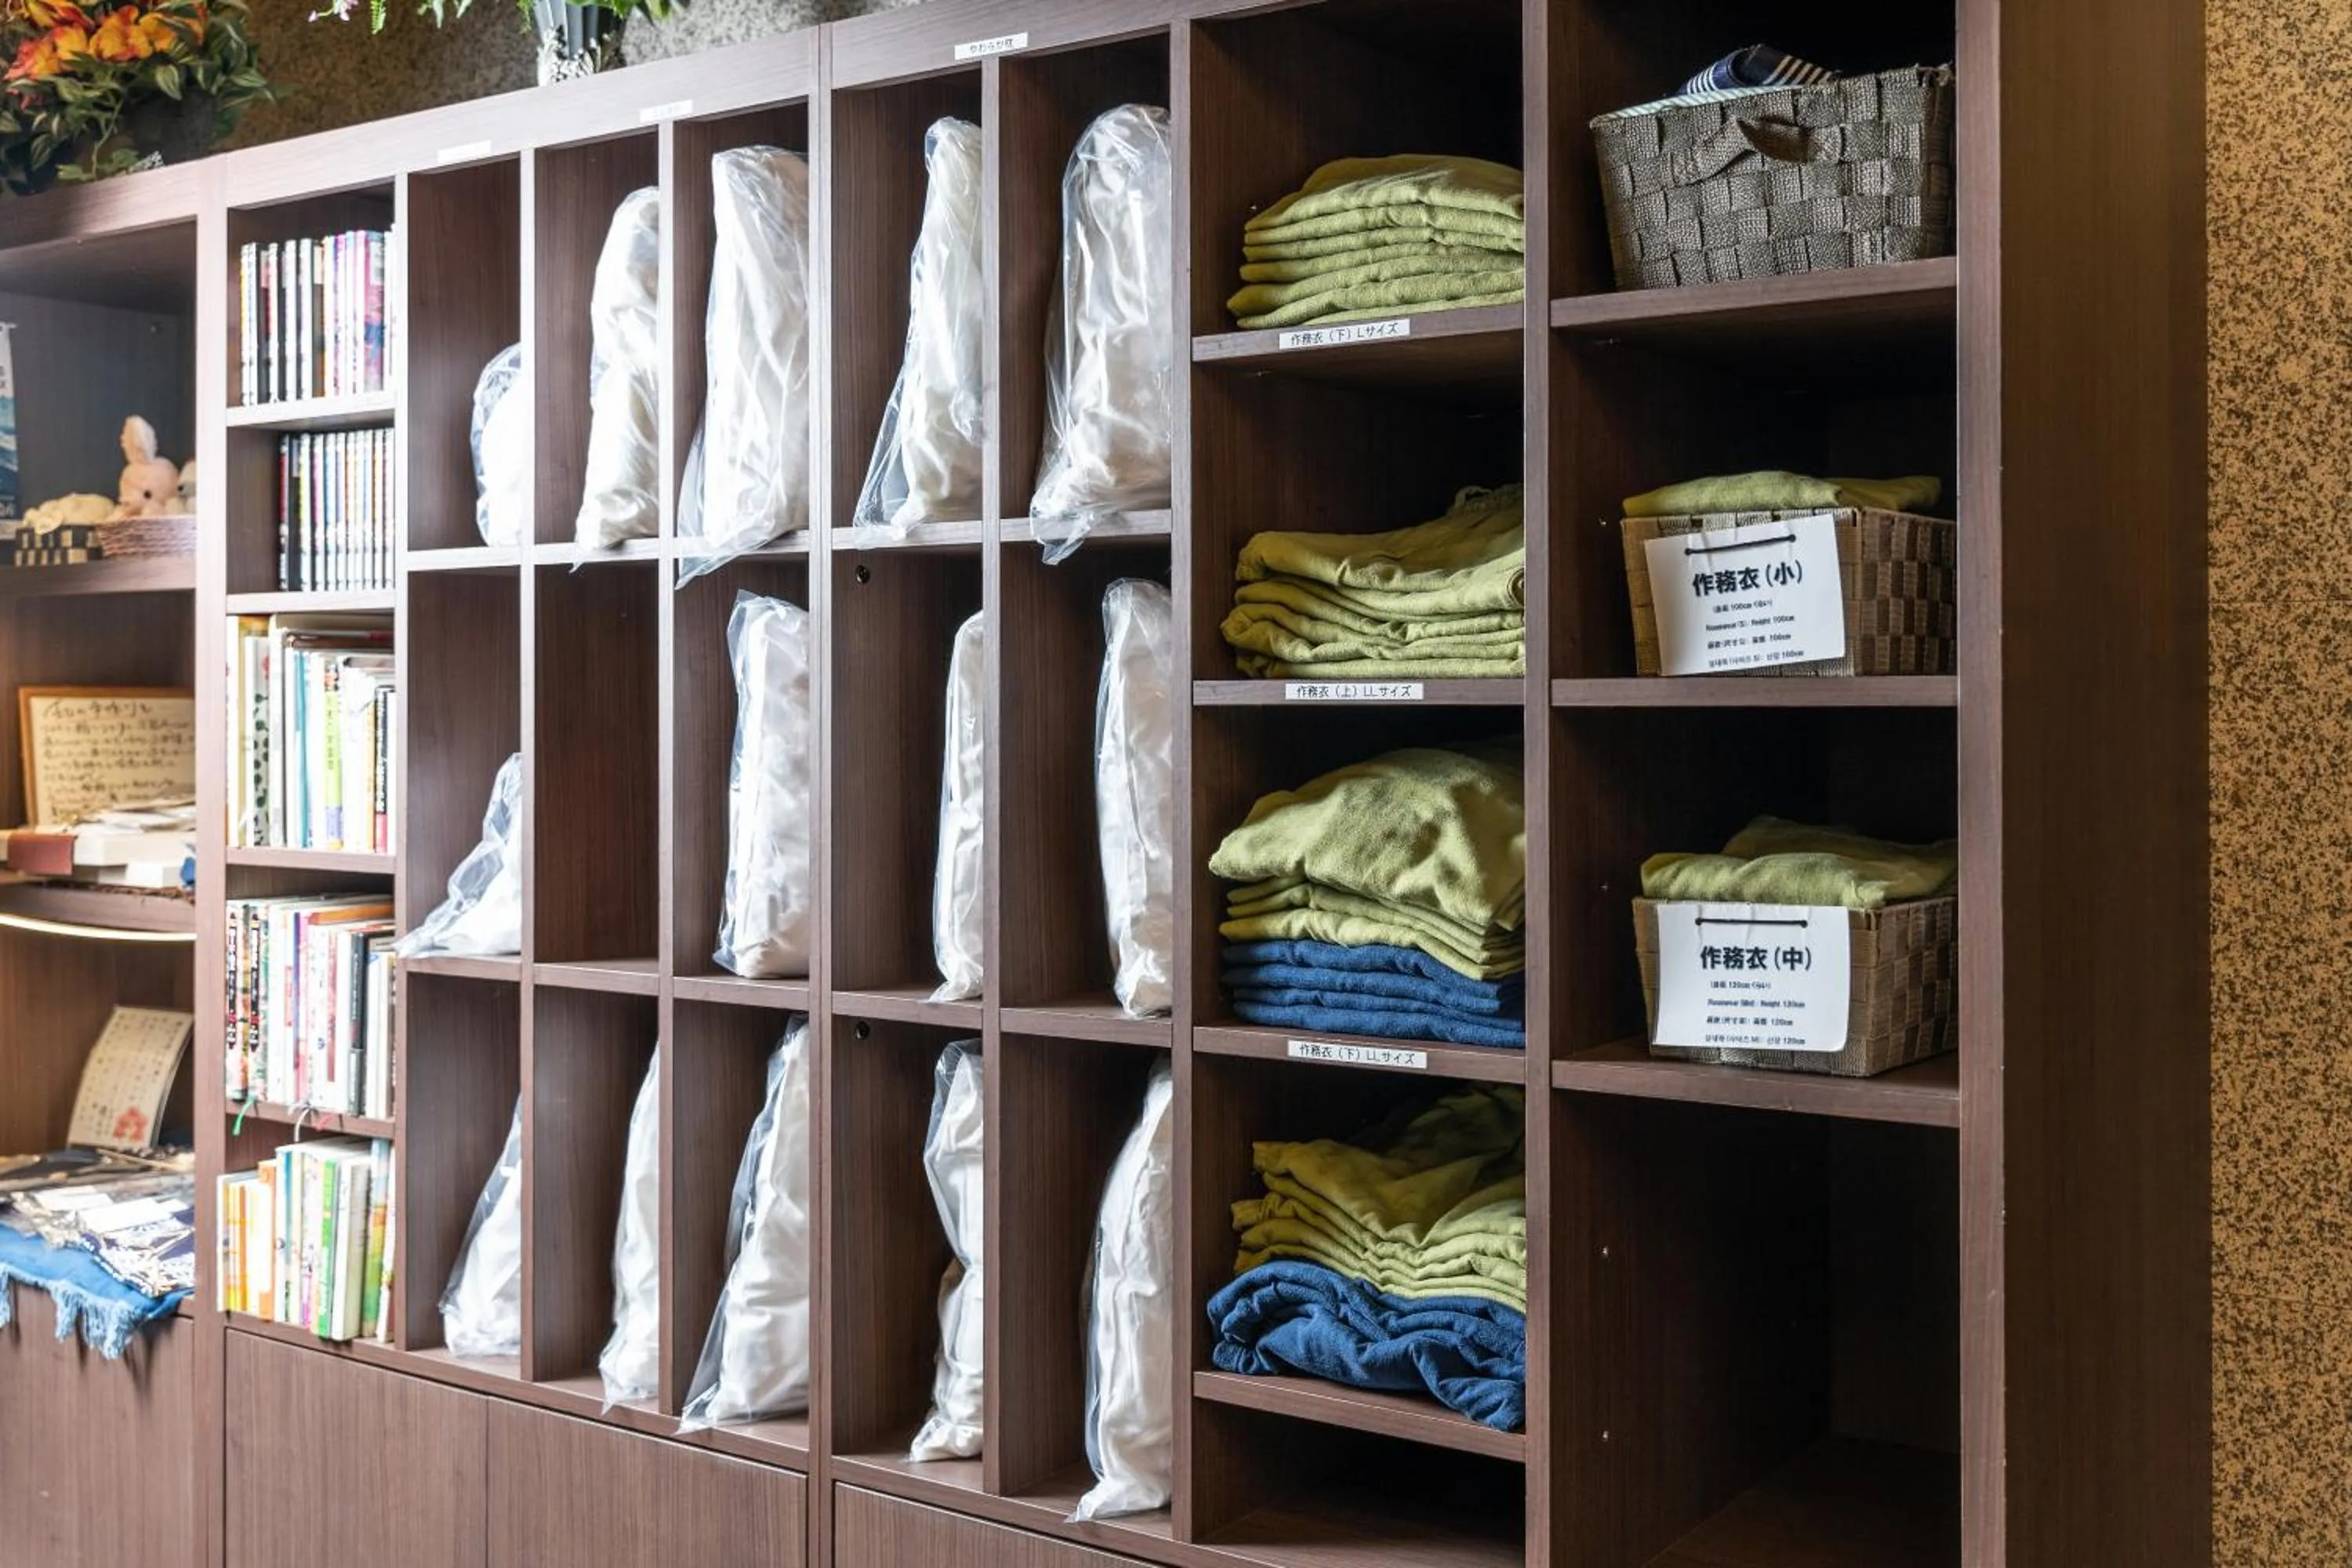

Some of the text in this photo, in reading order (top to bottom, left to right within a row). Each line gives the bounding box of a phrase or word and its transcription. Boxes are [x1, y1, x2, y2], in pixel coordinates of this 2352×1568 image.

[1692, 560, 1803, 597] 作務衣（小）
[1700, 946, 1812, 971] 作務衣（中）
